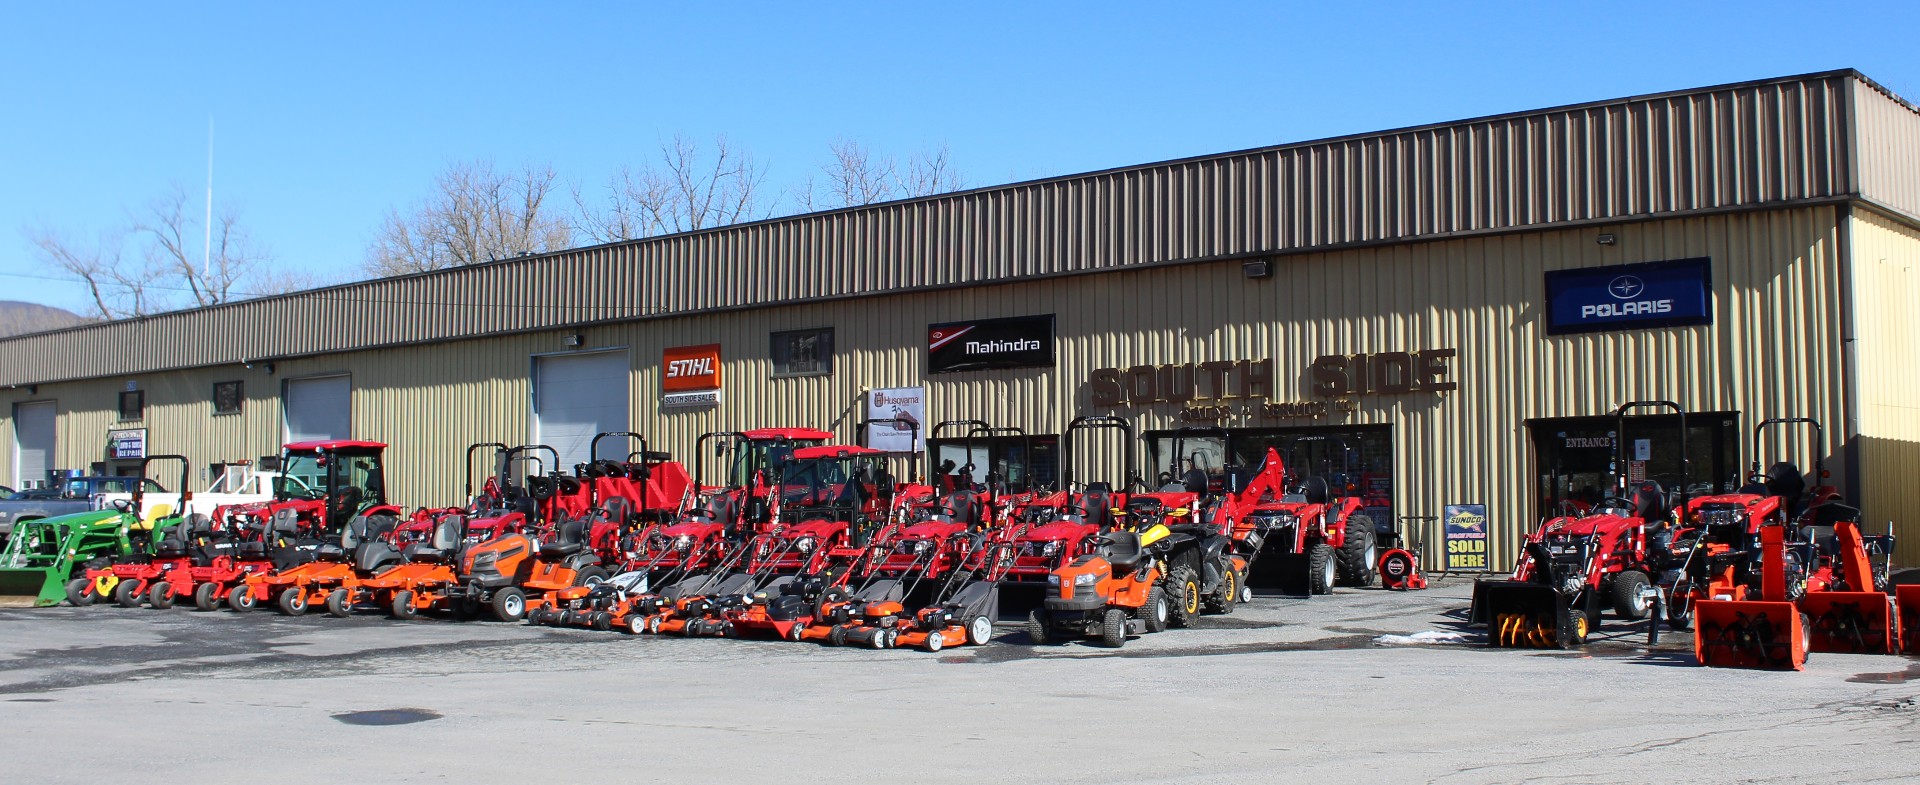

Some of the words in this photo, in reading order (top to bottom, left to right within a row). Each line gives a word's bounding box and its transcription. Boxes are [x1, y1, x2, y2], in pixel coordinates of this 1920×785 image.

[1581, 299, 1672, 318] POLARIS
[966, 338, 1040, 354] Mahindra
[667, 357, 714, 378] STIHL
[1091, 358, 1273, 406] SOUTH
[1313, 348, 1456, 397] SIDE
[665, 396, 683, 404] SOUTH
[684, 395, 697, 403] SIDE
[697, 393, 717, 402] SALES
[884, 396, 919, 406] Husqvarna
[1565, 437, 1610, 448] ENTRANCE
[1450, 516, 1482, 524] SUNOCO
[1447, 540, 1485, 553] SOLD
[1449, 554, 1485, 568] HERE
